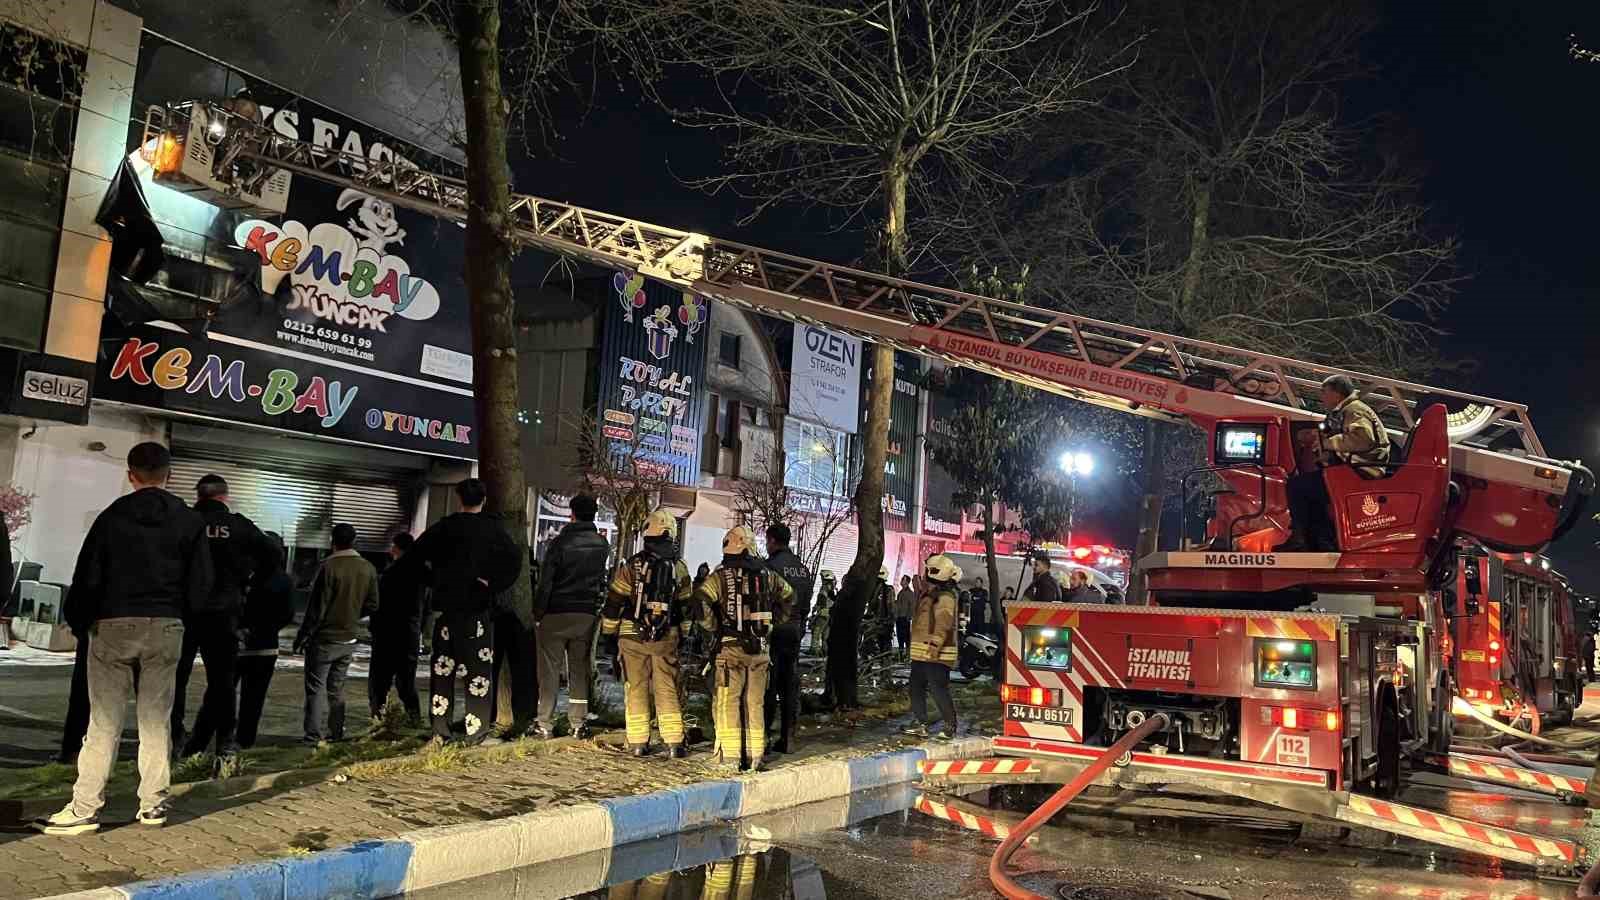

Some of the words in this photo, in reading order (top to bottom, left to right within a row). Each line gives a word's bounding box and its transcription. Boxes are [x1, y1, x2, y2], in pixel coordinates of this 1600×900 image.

[283, 319, 315, 334] 0212
[316, 328, 339, 341] 659
[341, 333, 355, 345] 61
[358, 337, 372, 349] 99
[27, 377, 84, 399] seluz
[365, 408, 472, 444] OYUNCAK
[206, 525, 230, 538] LİS
[1205, 554, 1276, 566] MAGIRUS
[1012, 706, 1026, 718] 34
[1028, 708, 1042, 719] AJ
[1281, 738, 1304, 753] 112
